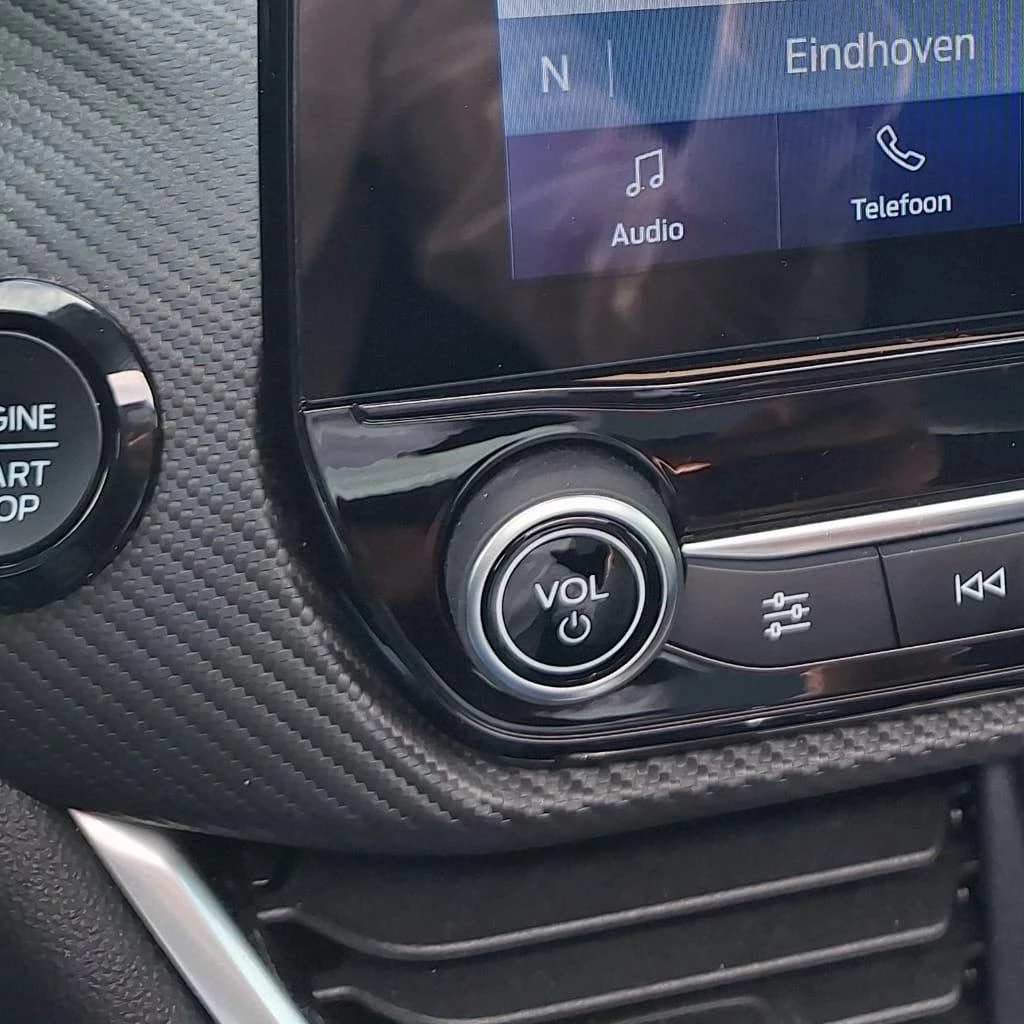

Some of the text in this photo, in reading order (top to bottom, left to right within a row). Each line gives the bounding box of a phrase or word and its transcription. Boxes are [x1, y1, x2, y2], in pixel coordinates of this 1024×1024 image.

[785, 31, 976, 74] Eindhoven
[540, 55, 571, 94] N
[850, 192, 952, 222] Telefoon
[610, 217, 685, 247] Audio
[534, 574, 609, 611] VOL
